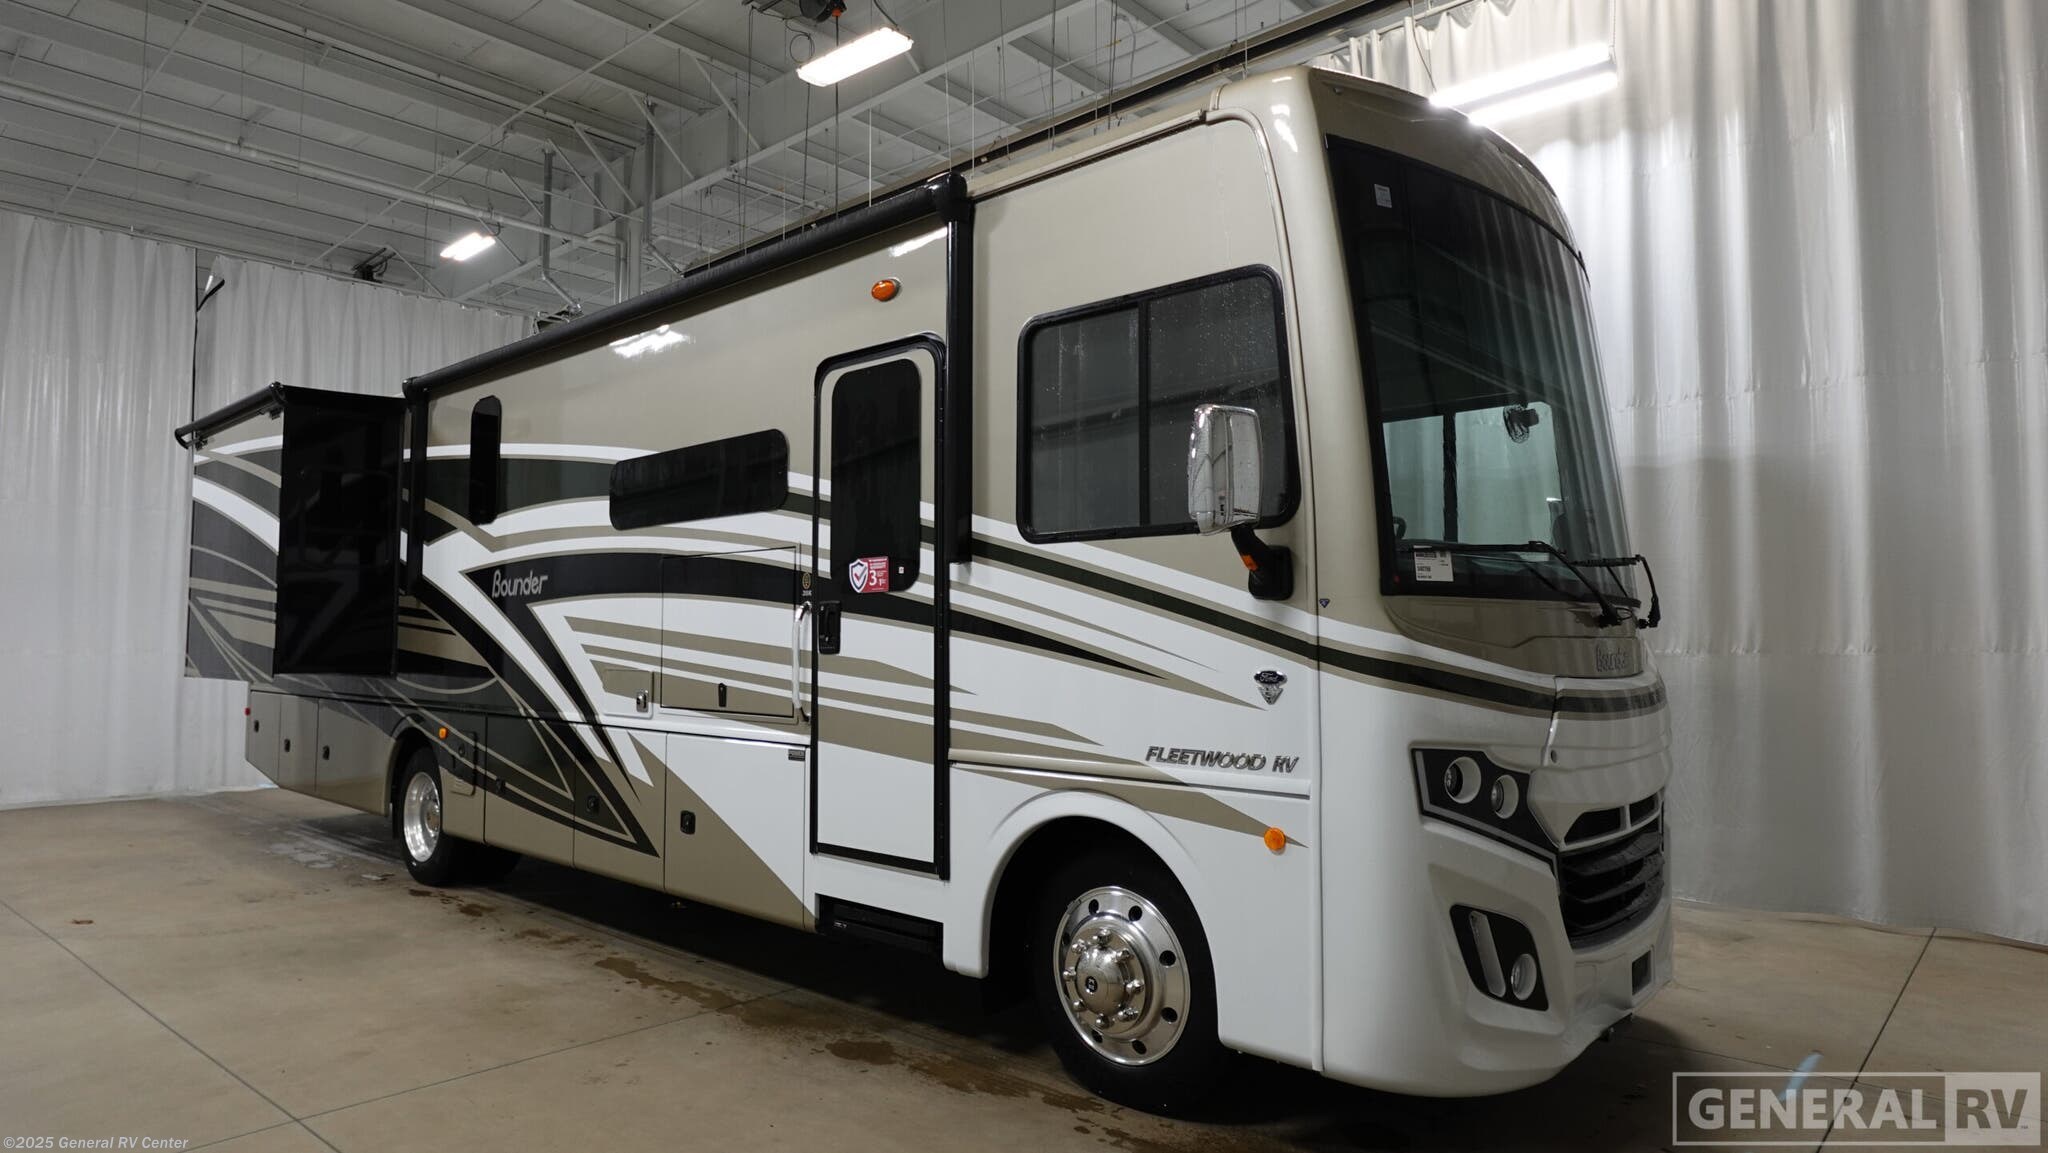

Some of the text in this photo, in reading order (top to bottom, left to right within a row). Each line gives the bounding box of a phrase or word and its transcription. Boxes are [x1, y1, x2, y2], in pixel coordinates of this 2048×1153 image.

[491, 569, 549, 599] Bounder
[869, 570, 877, 586] 3
[1145, 746, 1299, 773] FLEETWOOD RV
